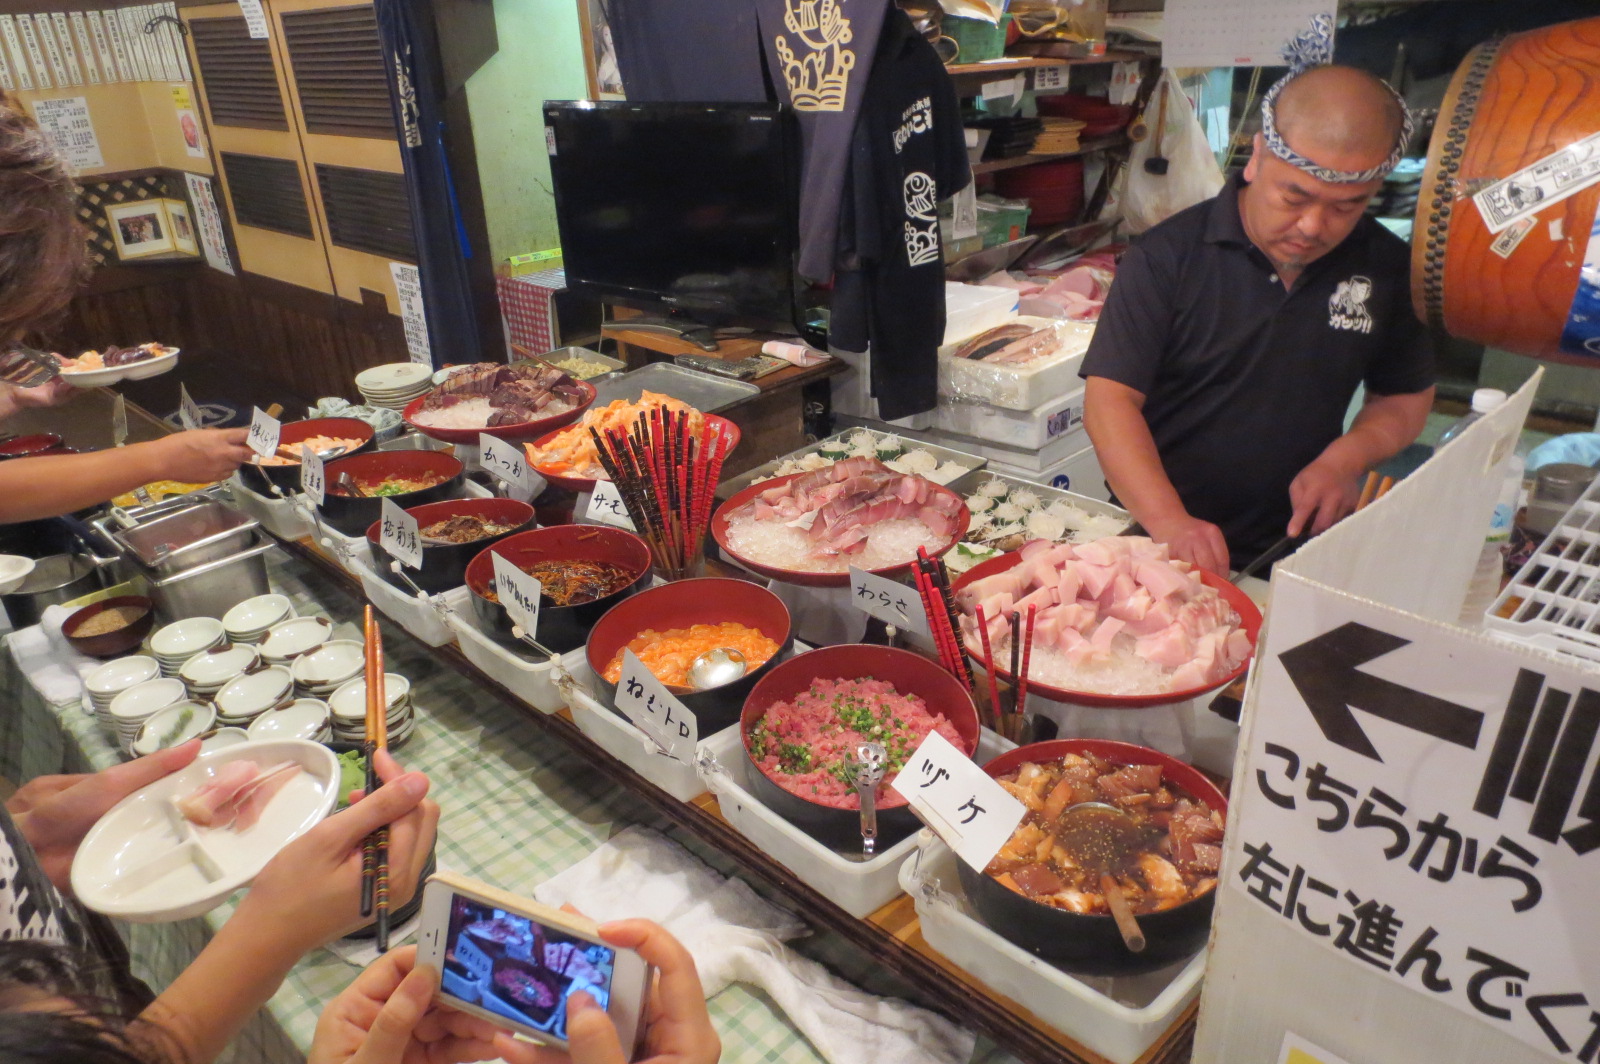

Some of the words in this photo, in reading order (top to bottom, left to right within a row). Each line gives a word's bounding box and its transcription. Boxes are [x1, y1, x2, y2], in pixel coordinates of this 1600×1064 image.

[484, 446, 522, 478] かつお
[856, 581, 909, 617] わらさ
[626, 675, 690, 740] ねぎトロ
[1256, 741, 1543, 914] こちらから
